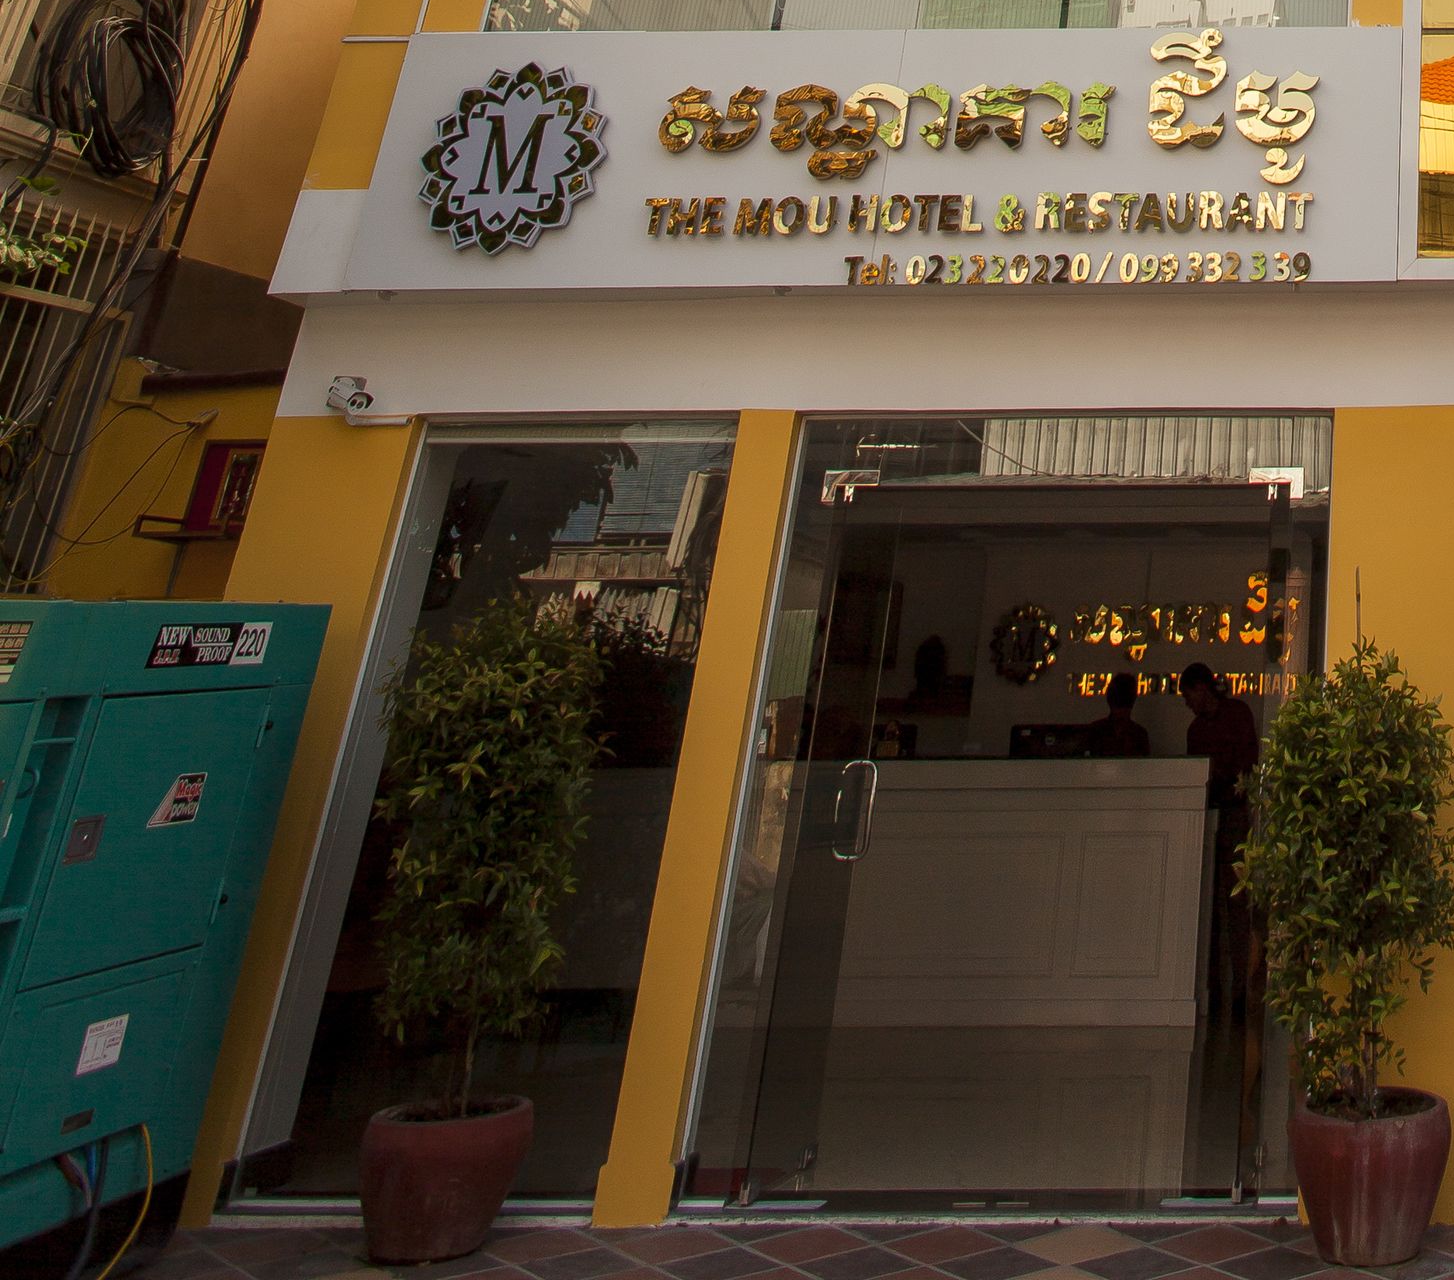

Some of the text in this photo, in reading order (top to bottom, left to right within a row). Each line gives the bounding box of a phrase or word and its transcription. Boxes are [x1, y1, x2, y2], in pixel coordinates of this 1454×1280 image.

[468, 114, 556, 196] M
[646, 191, 1314, 235] THE MOU HOTEL & RESTAURANT
[844, 253, 897, 285] Tel:
[158, 626, 231, 646] NEW SOUND
[236, 628, 266, 657] 220
[195, 646, 232, 662] PROOF
[175, 779, 203, 801] Magic
